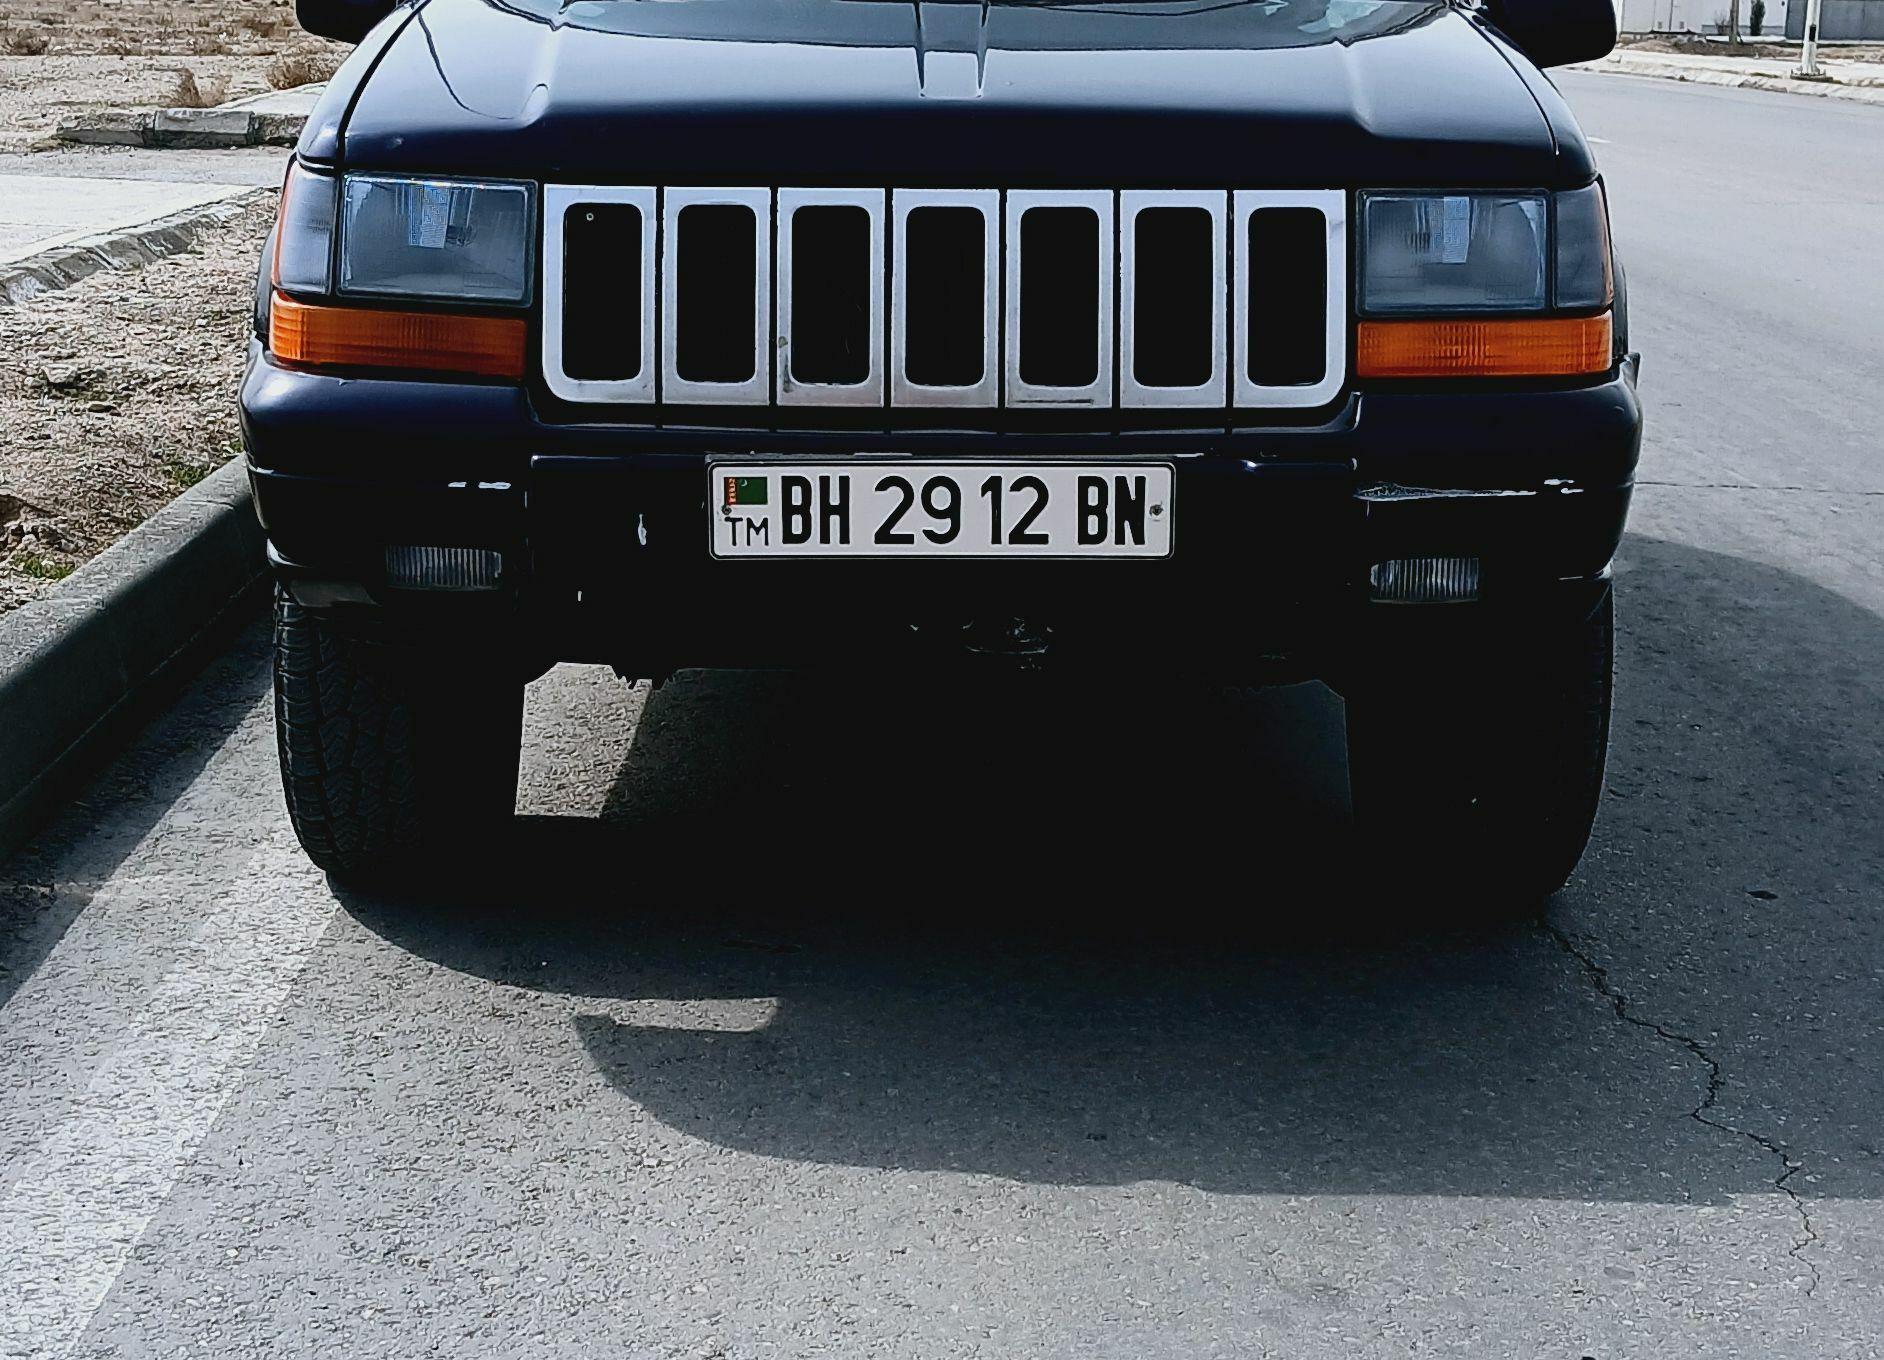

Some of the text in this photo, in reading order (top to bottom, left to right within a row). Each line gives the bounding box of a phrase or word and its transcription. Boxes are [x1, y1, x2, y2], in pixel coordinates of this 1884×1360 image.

[723, 516, 769, 547] TM
[780, 475, 1147, 546] BH 29 12 BN
